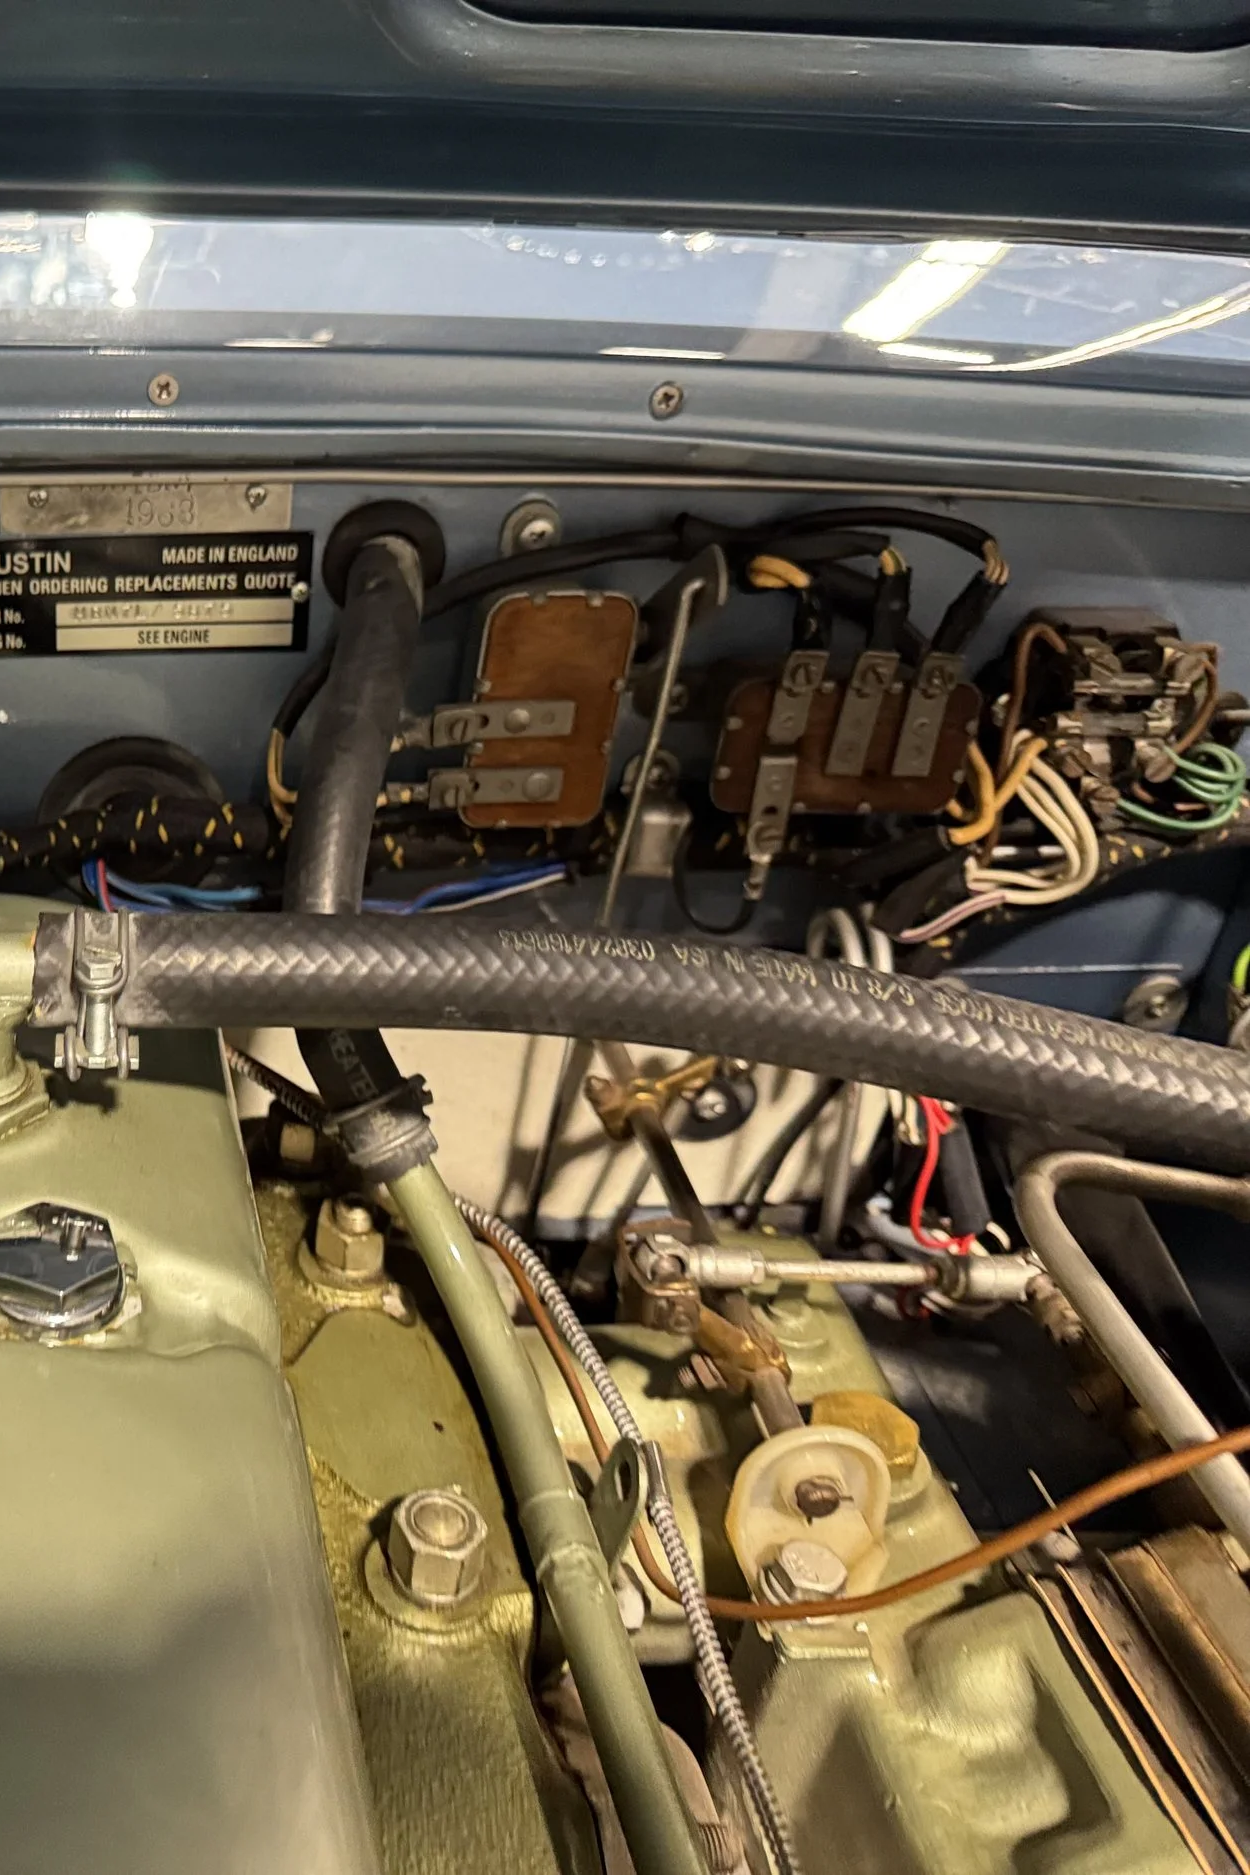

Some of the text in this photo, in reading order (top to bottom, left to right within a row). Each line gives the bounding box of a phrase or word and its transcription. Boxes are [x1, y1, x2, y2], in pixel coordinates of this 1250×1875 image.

[162, 544, 298, 565] MADE IN ENGLAND
[29, 576, 109, 595] ORDERING
[115, 574, 237, 593] REPLACEMENTS
[245, 573, 296, 590] QUOTE
[5, 607, 25, 624] No.
[5, 632, 26, 649] No.
[138, 628, 211, 645] SEE ENGINE
